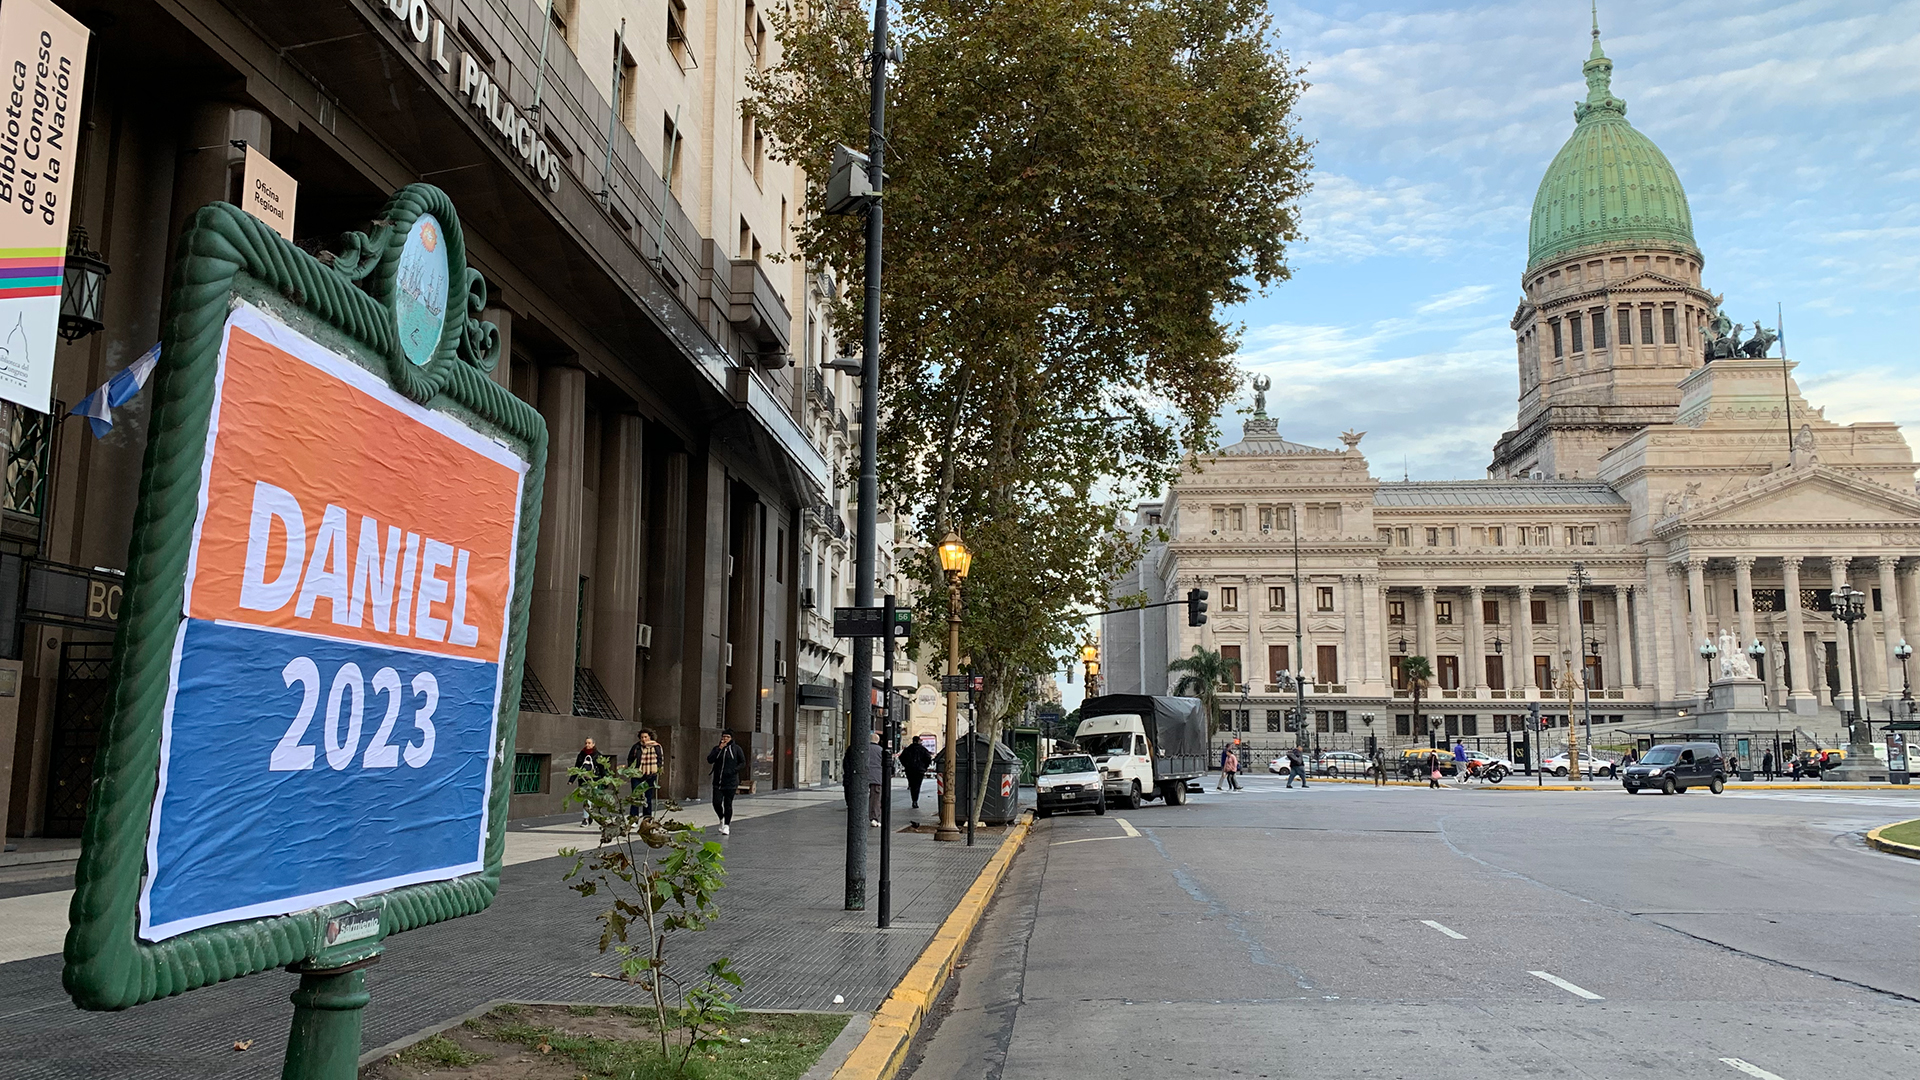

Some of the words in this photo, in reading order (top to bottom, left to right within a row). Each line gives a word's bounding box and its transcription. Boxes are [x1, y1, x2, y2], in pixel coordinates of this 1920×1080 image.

[24, 30, 52, 161] Congreso
[47, 56, 71, 150] Nación
[432, 19, 450, 74] L
[460, 51, 560, 193] PALACIOS
[0, 60, 27, 204] Biblioteca
[18, 168, 38, 215] del
[43, 157, 61, 184] la
[255, 179, 280, 203] Oficina
[39, 191, 57, 226] de
[254, 191, 284, 220] Regional
[239, 480, 480, 648] DANIEL
[898, 613, 908, 621] 56
[269, 656, 440, 772] 2023
[341, 917, 380, 934] Sarmiento
